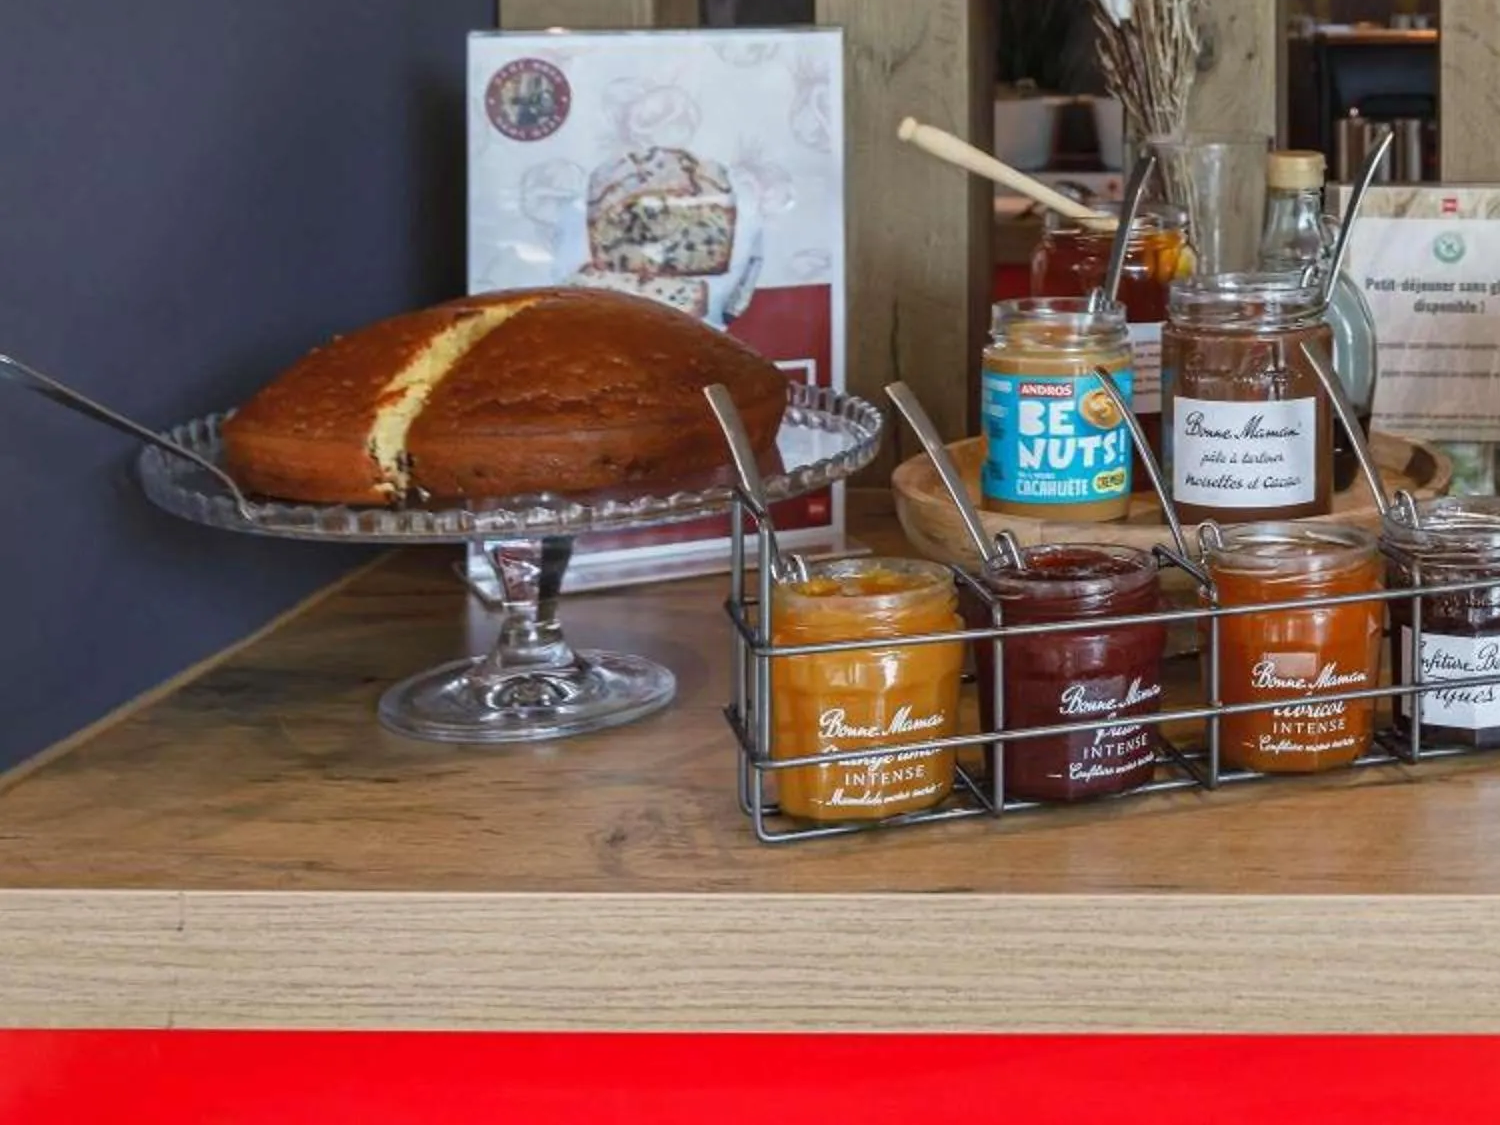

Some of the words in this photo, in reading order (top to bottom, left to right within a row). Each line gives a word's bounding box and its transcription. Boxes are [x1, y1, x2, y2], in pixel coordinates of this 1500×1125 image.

[1458, 281, 1488, 293] sans
[1021, 383, 1073, 396] ANDROS
[1018, 399, 1076, 436] BE
[1184, 410, 1233, 440] Bonne
[1233, 411, 1301, 440] Maman
[1017, 427, 1126, 470] NUTS!
[1250, 659, 1307, 689] Bonne
[1307, 661, 1369, 689] Maman
[1059, 683, 1117, 715] Bonne
[818, 707, 881, 738] Bonne
[1272, 718, 1346, 735] INTENSE
[1083, 731, 1149, 760] INTENSE
[844, 764, 926, 786] INTENSE
